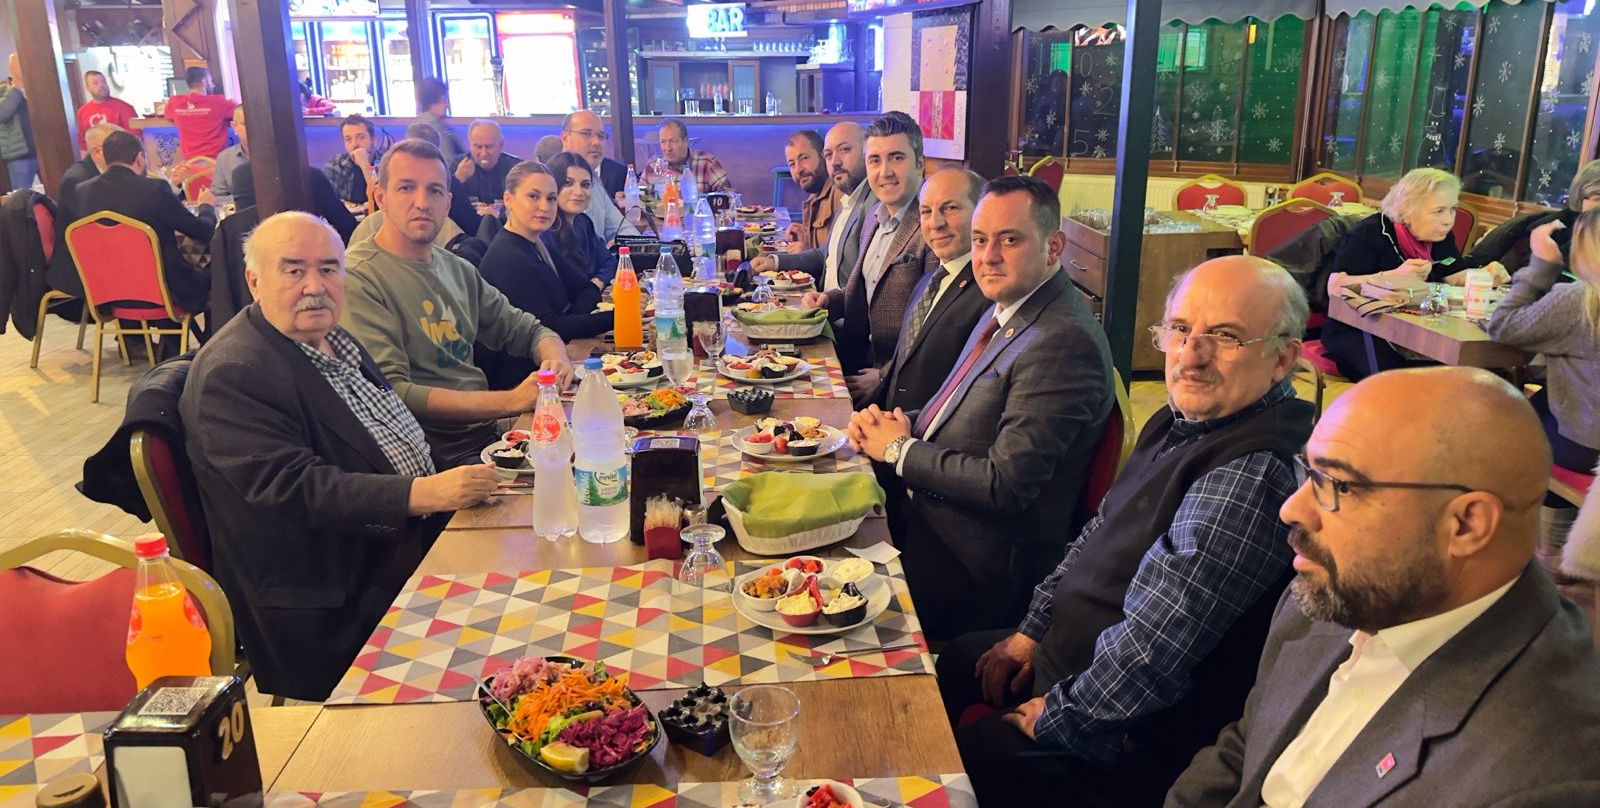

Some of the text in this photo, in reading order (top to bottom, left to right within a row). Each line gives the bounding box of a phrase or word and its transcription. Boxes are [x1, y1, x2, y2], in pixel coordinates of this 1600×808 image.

[706, 8, 744, 32] BAR
[712, 197, 723, 207] 10
[218, 701, 244, 760] 20
